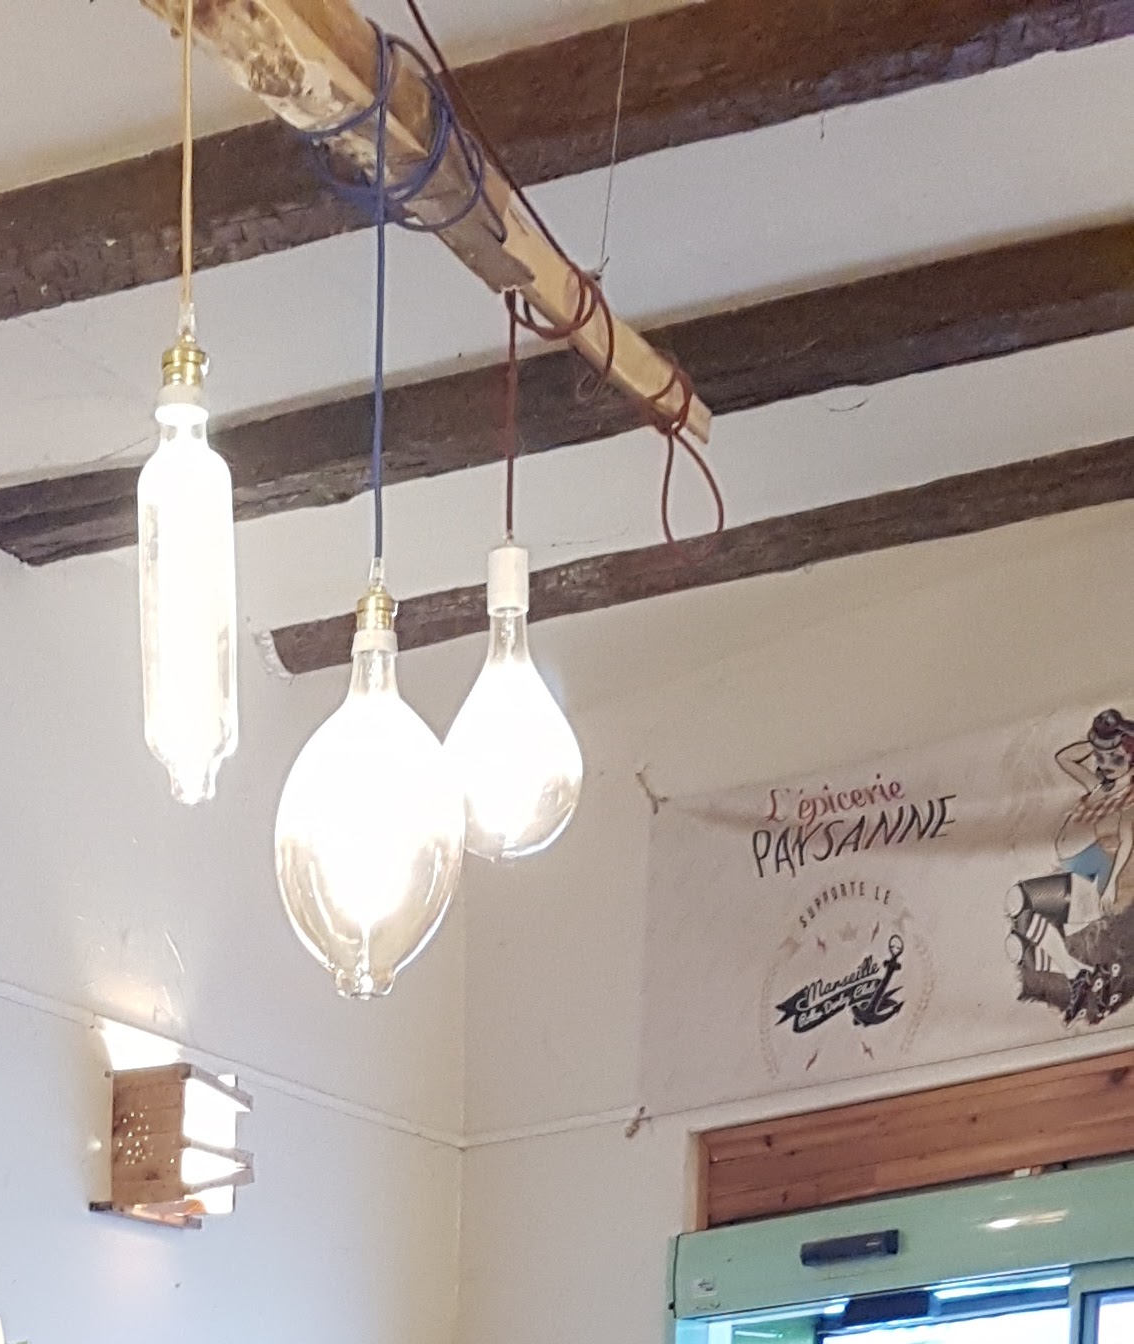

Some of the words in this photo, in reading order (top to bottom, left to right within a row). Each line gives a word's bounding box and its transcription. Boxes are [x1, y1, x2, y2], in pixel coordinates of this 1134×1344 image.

[765, 773, 905, 826] L'épicerie
[752, 794, 956, 878] PAYSANNE
[799, 881, 865, 929] SUPPORTE
[874, 884, 891, 905] LE
[796, 954, 880, 1011] Marseille
